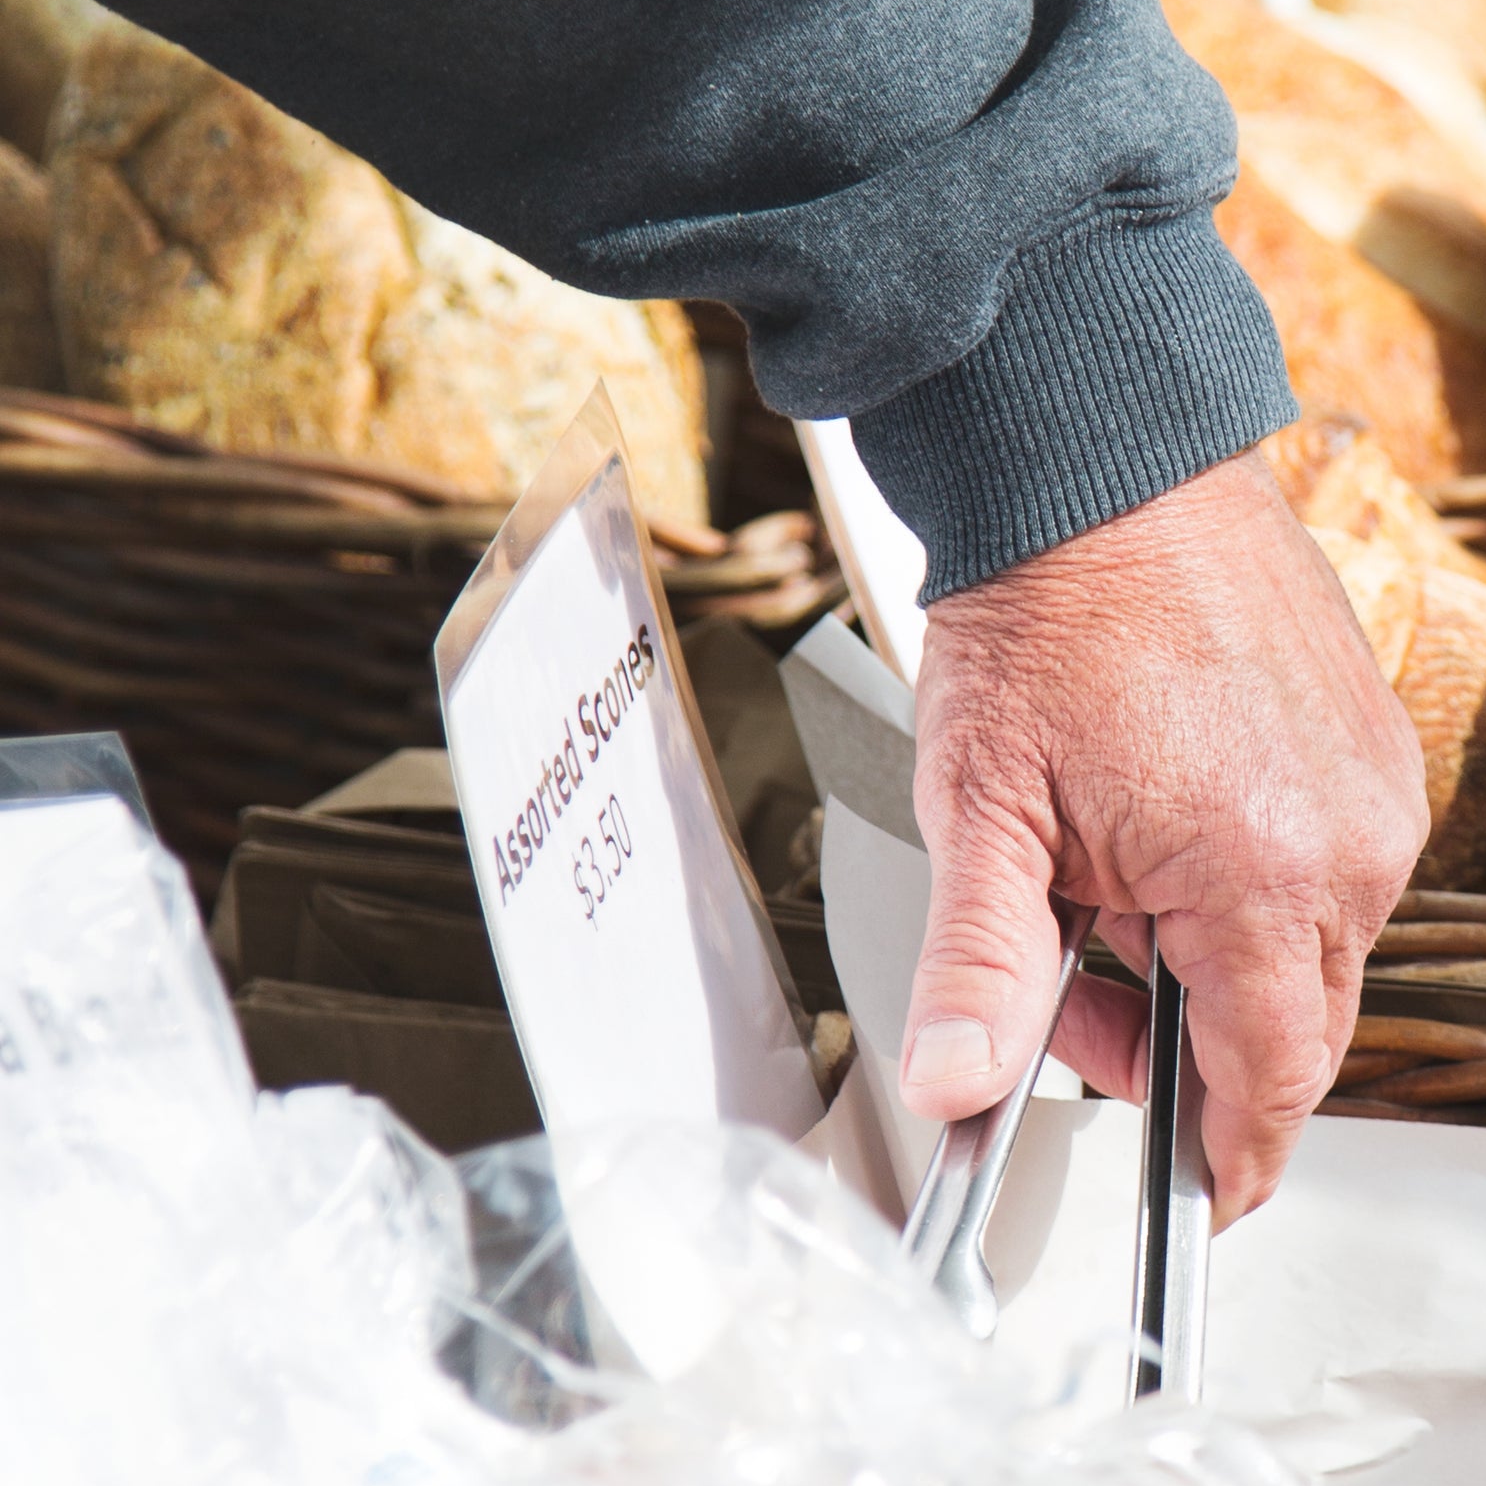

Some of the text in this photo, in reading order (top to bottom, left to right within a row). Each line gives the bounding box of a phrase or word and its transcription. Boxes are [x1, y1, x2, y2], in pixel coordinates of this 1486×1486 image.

[493, 622, 656, 908] Assorted Scones
[572, 792, 632, 932] $3.50
